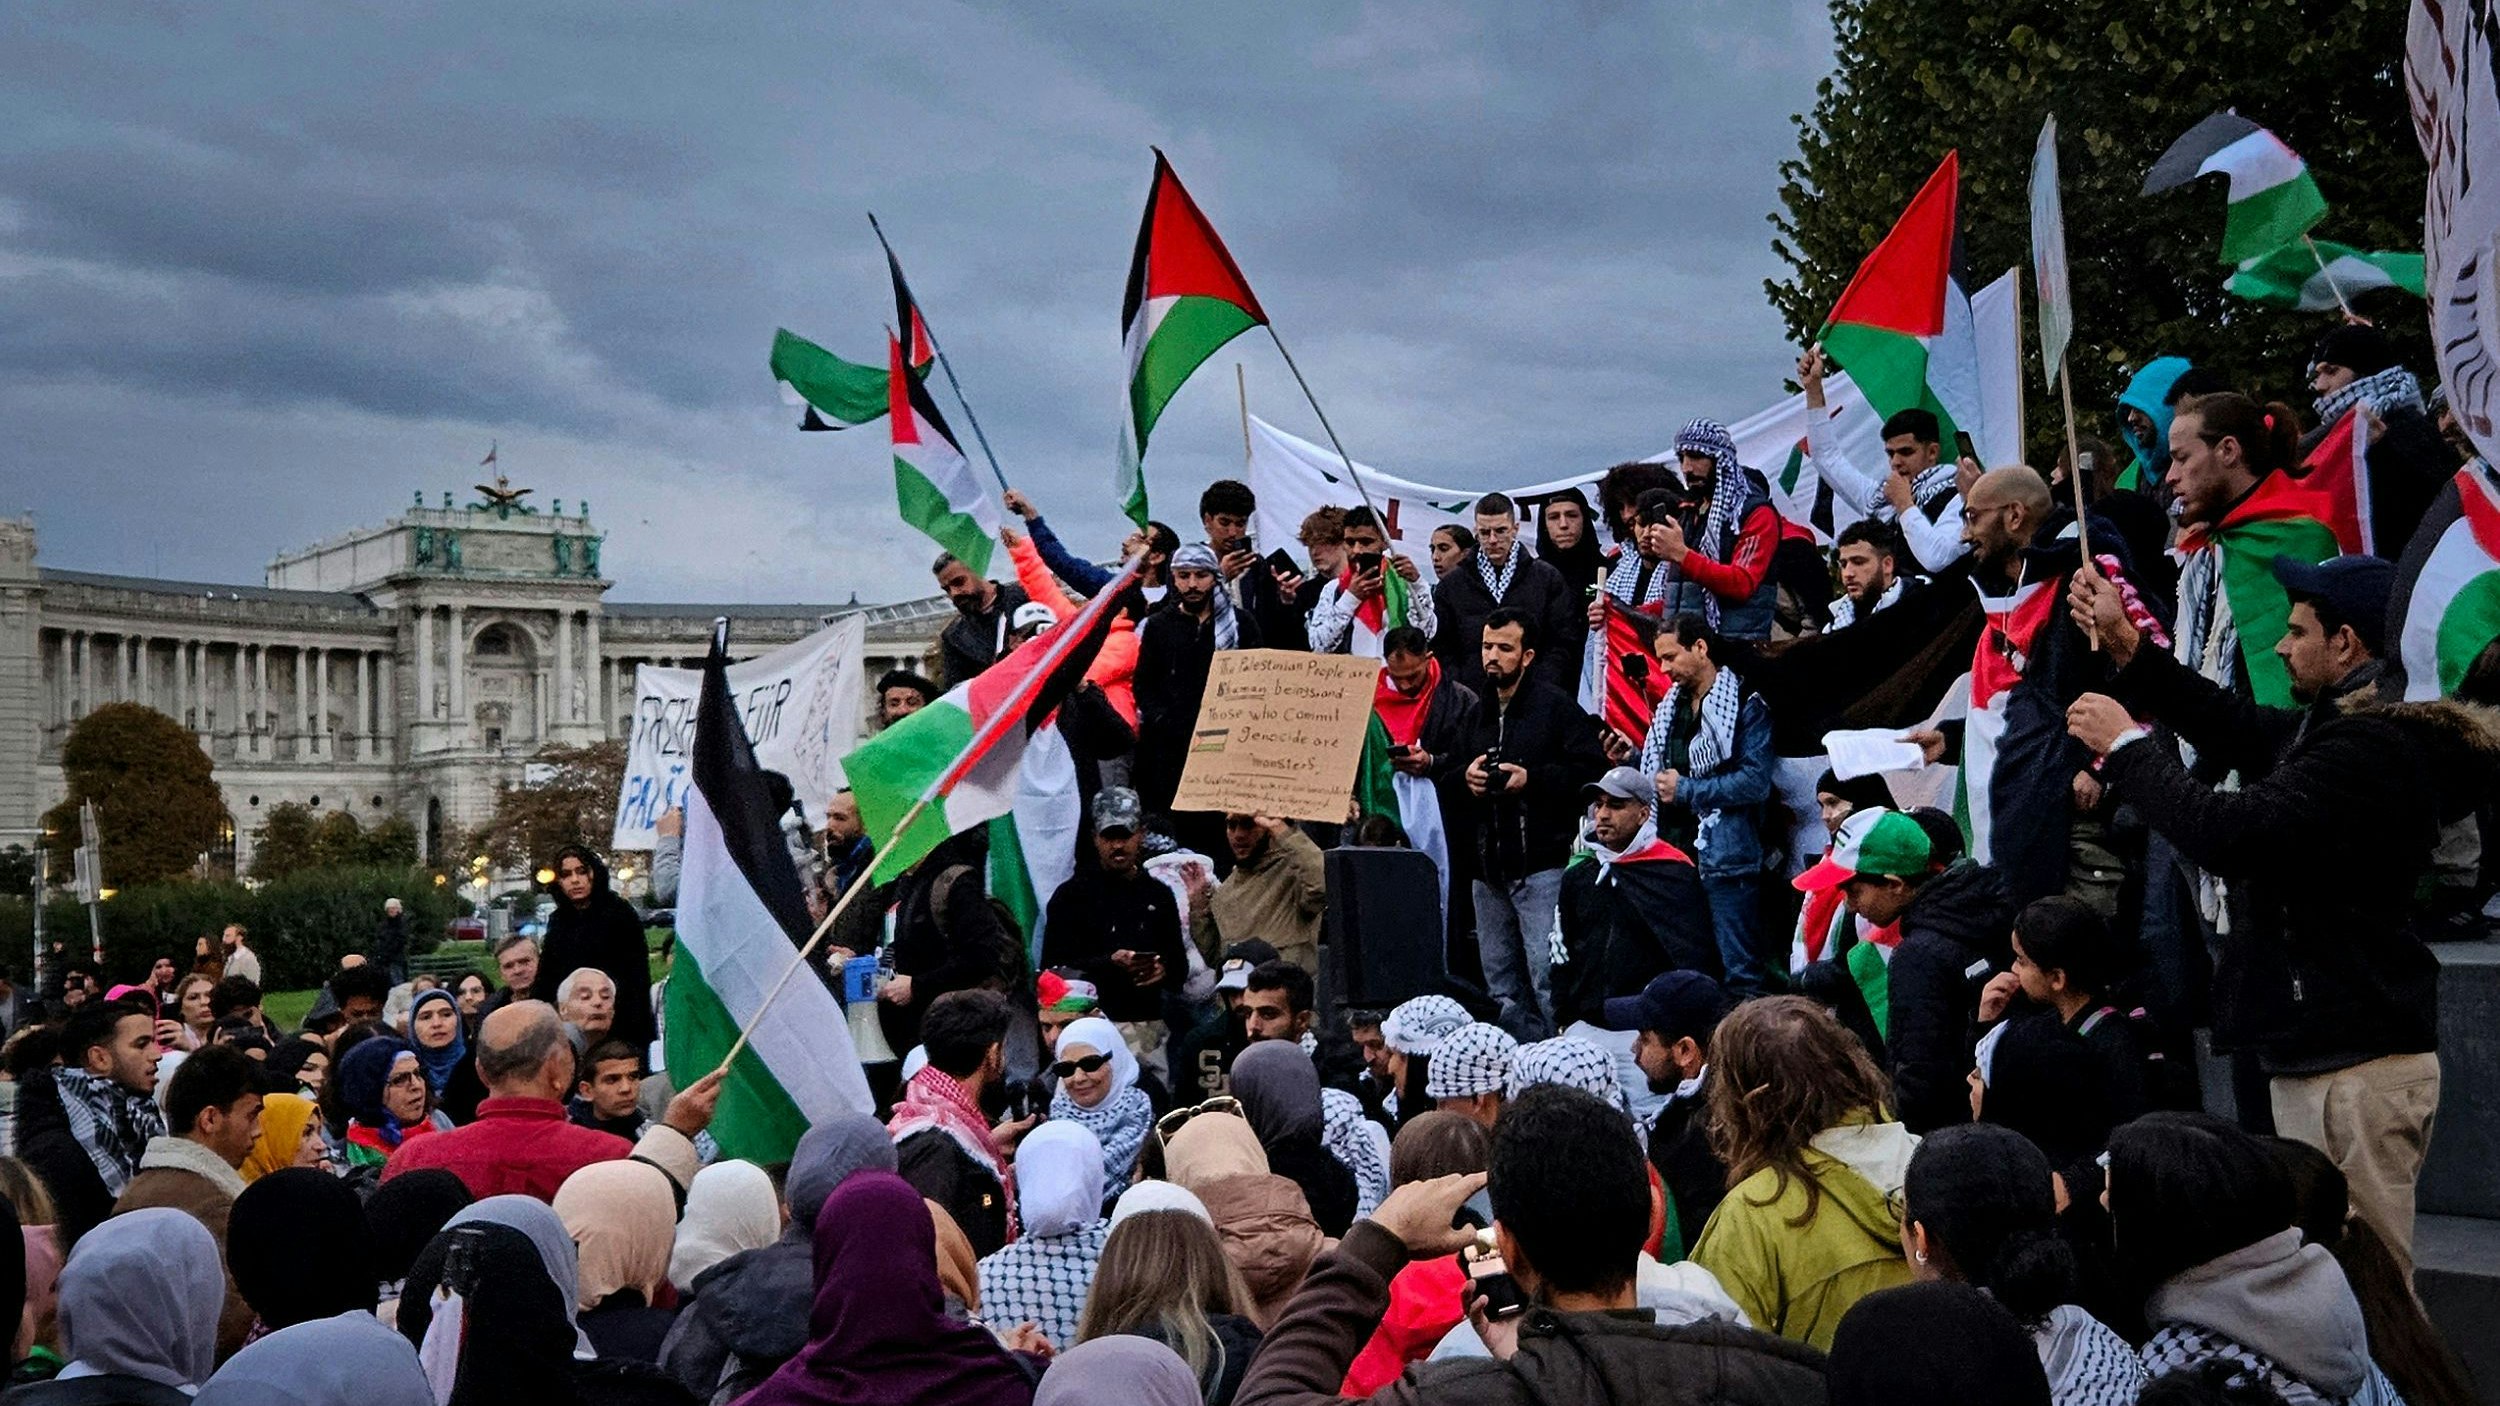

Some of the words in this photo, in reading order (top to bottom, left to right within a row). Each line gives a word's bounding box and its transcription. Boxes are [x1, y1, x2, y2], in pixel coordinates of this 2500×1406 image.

[1306, 659, 1344, 681] People
[1348, 669, 1374, 680] are
[1248, 703, 1279, 721] who
[1312, 738, 1339, 749] are
